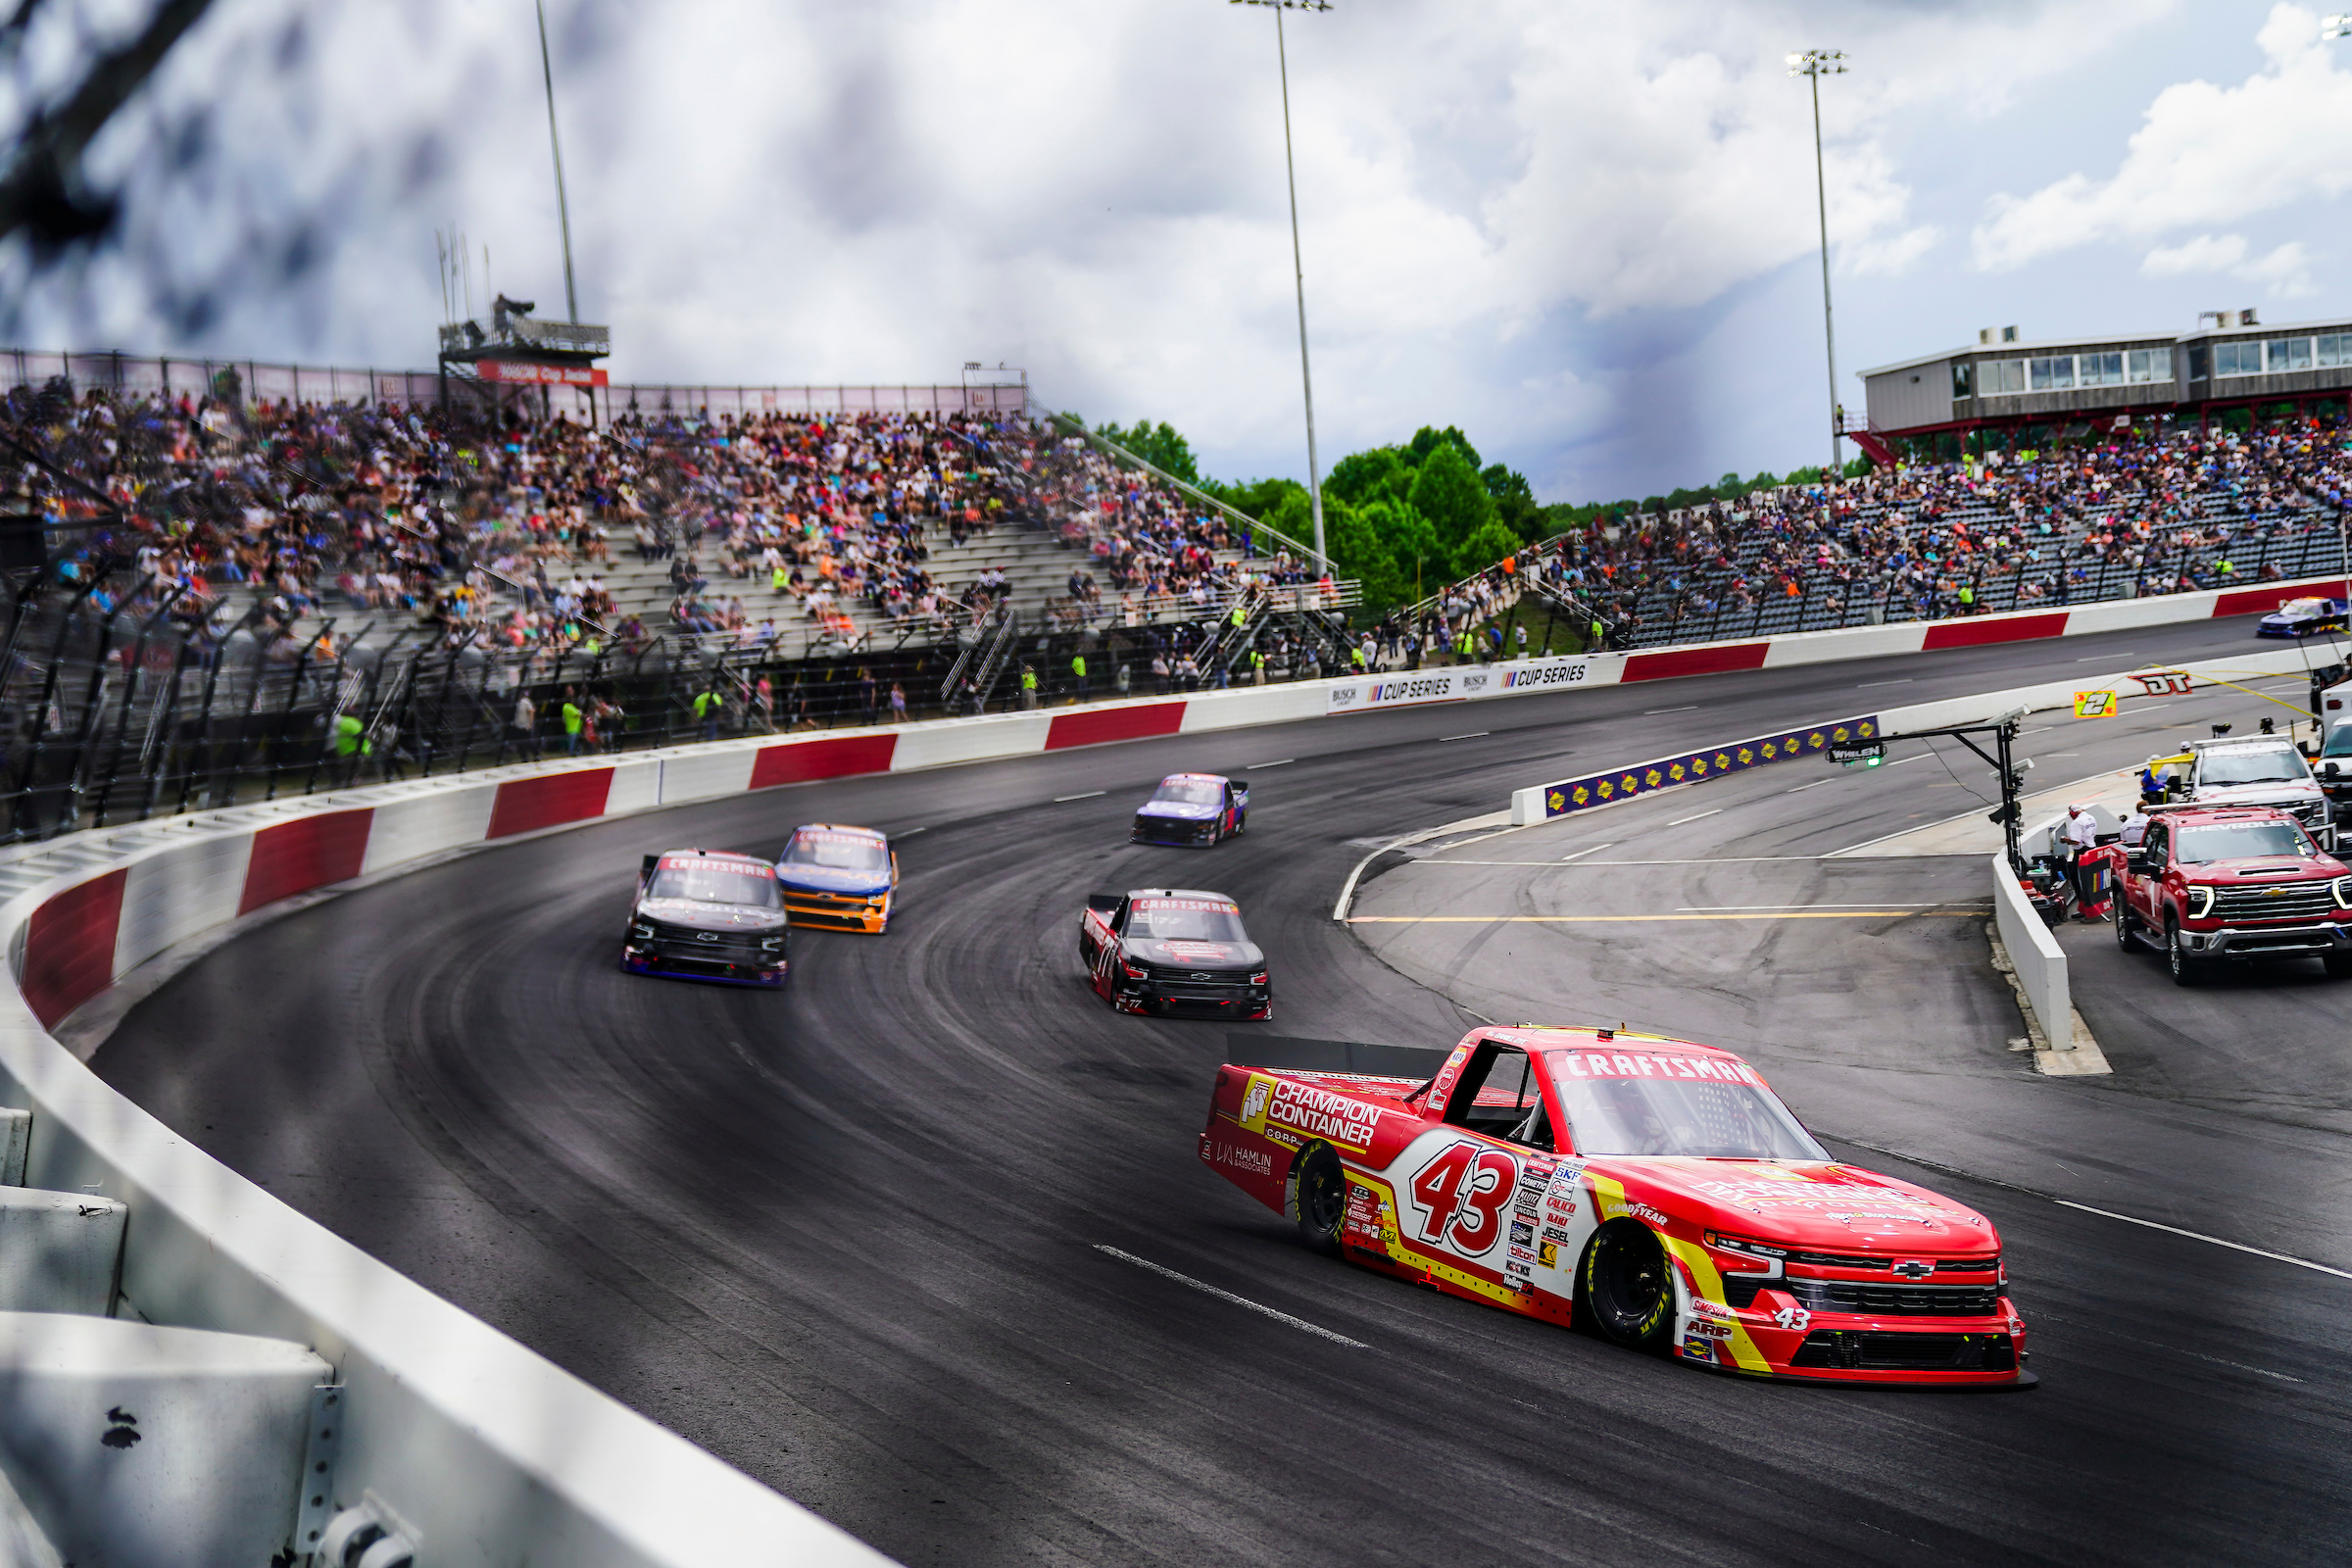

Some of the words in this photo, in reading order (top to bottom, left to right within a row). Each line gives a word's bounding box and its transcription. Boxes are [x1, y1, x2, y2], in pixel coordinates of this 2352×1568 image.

[540, 366, 563, 383] Cup
[1463, 674, 1488, 688] BUSCH
[1517, 668, 1543, 686] CUP
[1543, 664, 1586, 684] SERIES
[1333, 689, 1356, 702] BUSCH
[1384, 683, 1408, 700] CUP
[1409, 678, 1451, 698] SERIES
[2081, 693, 2111, 715] 2
[2180, 819, 2291, 834] CHEVROLET
[799, 831, 877, 847] CRAFTSMAN
[668, 857, 766, 877] CRAFTSMAN
[1140, 899, 1233, 913] CRAFTSMAN
[1129, 999, 1142, 1008] 77
[1565, 1054, 1758, 1085] CRAFTSMAN
[1274, 1081, 1383, 1126] CHAMPION
[1269, 1100, 1374, 1147] CONTAINER
[1235, 1147, 1272, 1167] HAMLIN
[1528, 1158, 1555, 1172] CRAFTSMAN
[1555, 1166, 1581, 1181] SKF
[1520, 1176, 1547, 1191] COMETIC
[1409, 1140, 1519, 1258] 43
[1520, 1190, 1540, 1204] KLOTZ
[1546, 1197, 1576, 1213] CALICO
[1514, 1205, 1538, 1217] LINCOLN
[1607, 1202, 1668, 1226] GOODYEAR
[1546, 1212, 1568, 1227] DART
[1542, 1227, 1569, 1243] JESEL
[1510, 1245, 1536, 1262] tilton
[1503, 1273, 1524, 1292] Holley
[1693, 1300, 1731, 1317] SIMPSON
[1775, 1307, 1812, 1331] 43
[1687, 1321, 1733, 1337] ARP
